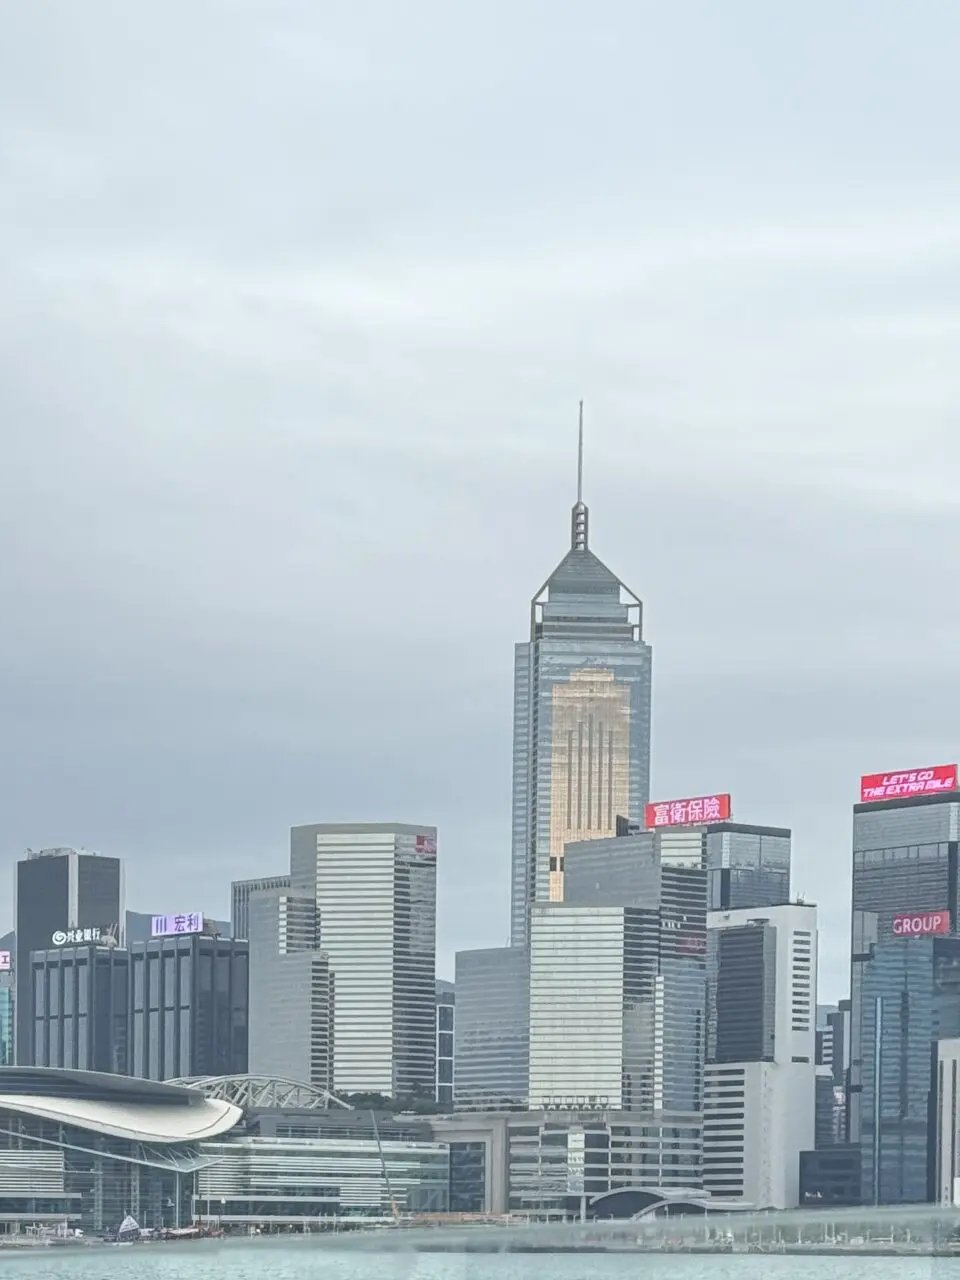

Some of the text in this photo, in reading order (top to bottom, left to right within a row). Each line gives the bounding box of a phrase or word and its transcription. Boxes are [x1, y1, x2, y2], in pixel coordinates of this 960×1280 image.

[863, 777, 954, 798] THE EXTRA MILE
[882, 770, 934, 786] LET'S GO
[653, 797, 720, 825] 富衛保險
[174, 913, 199, 932] 宏利
[893, 915, 942, 934] GROUP
